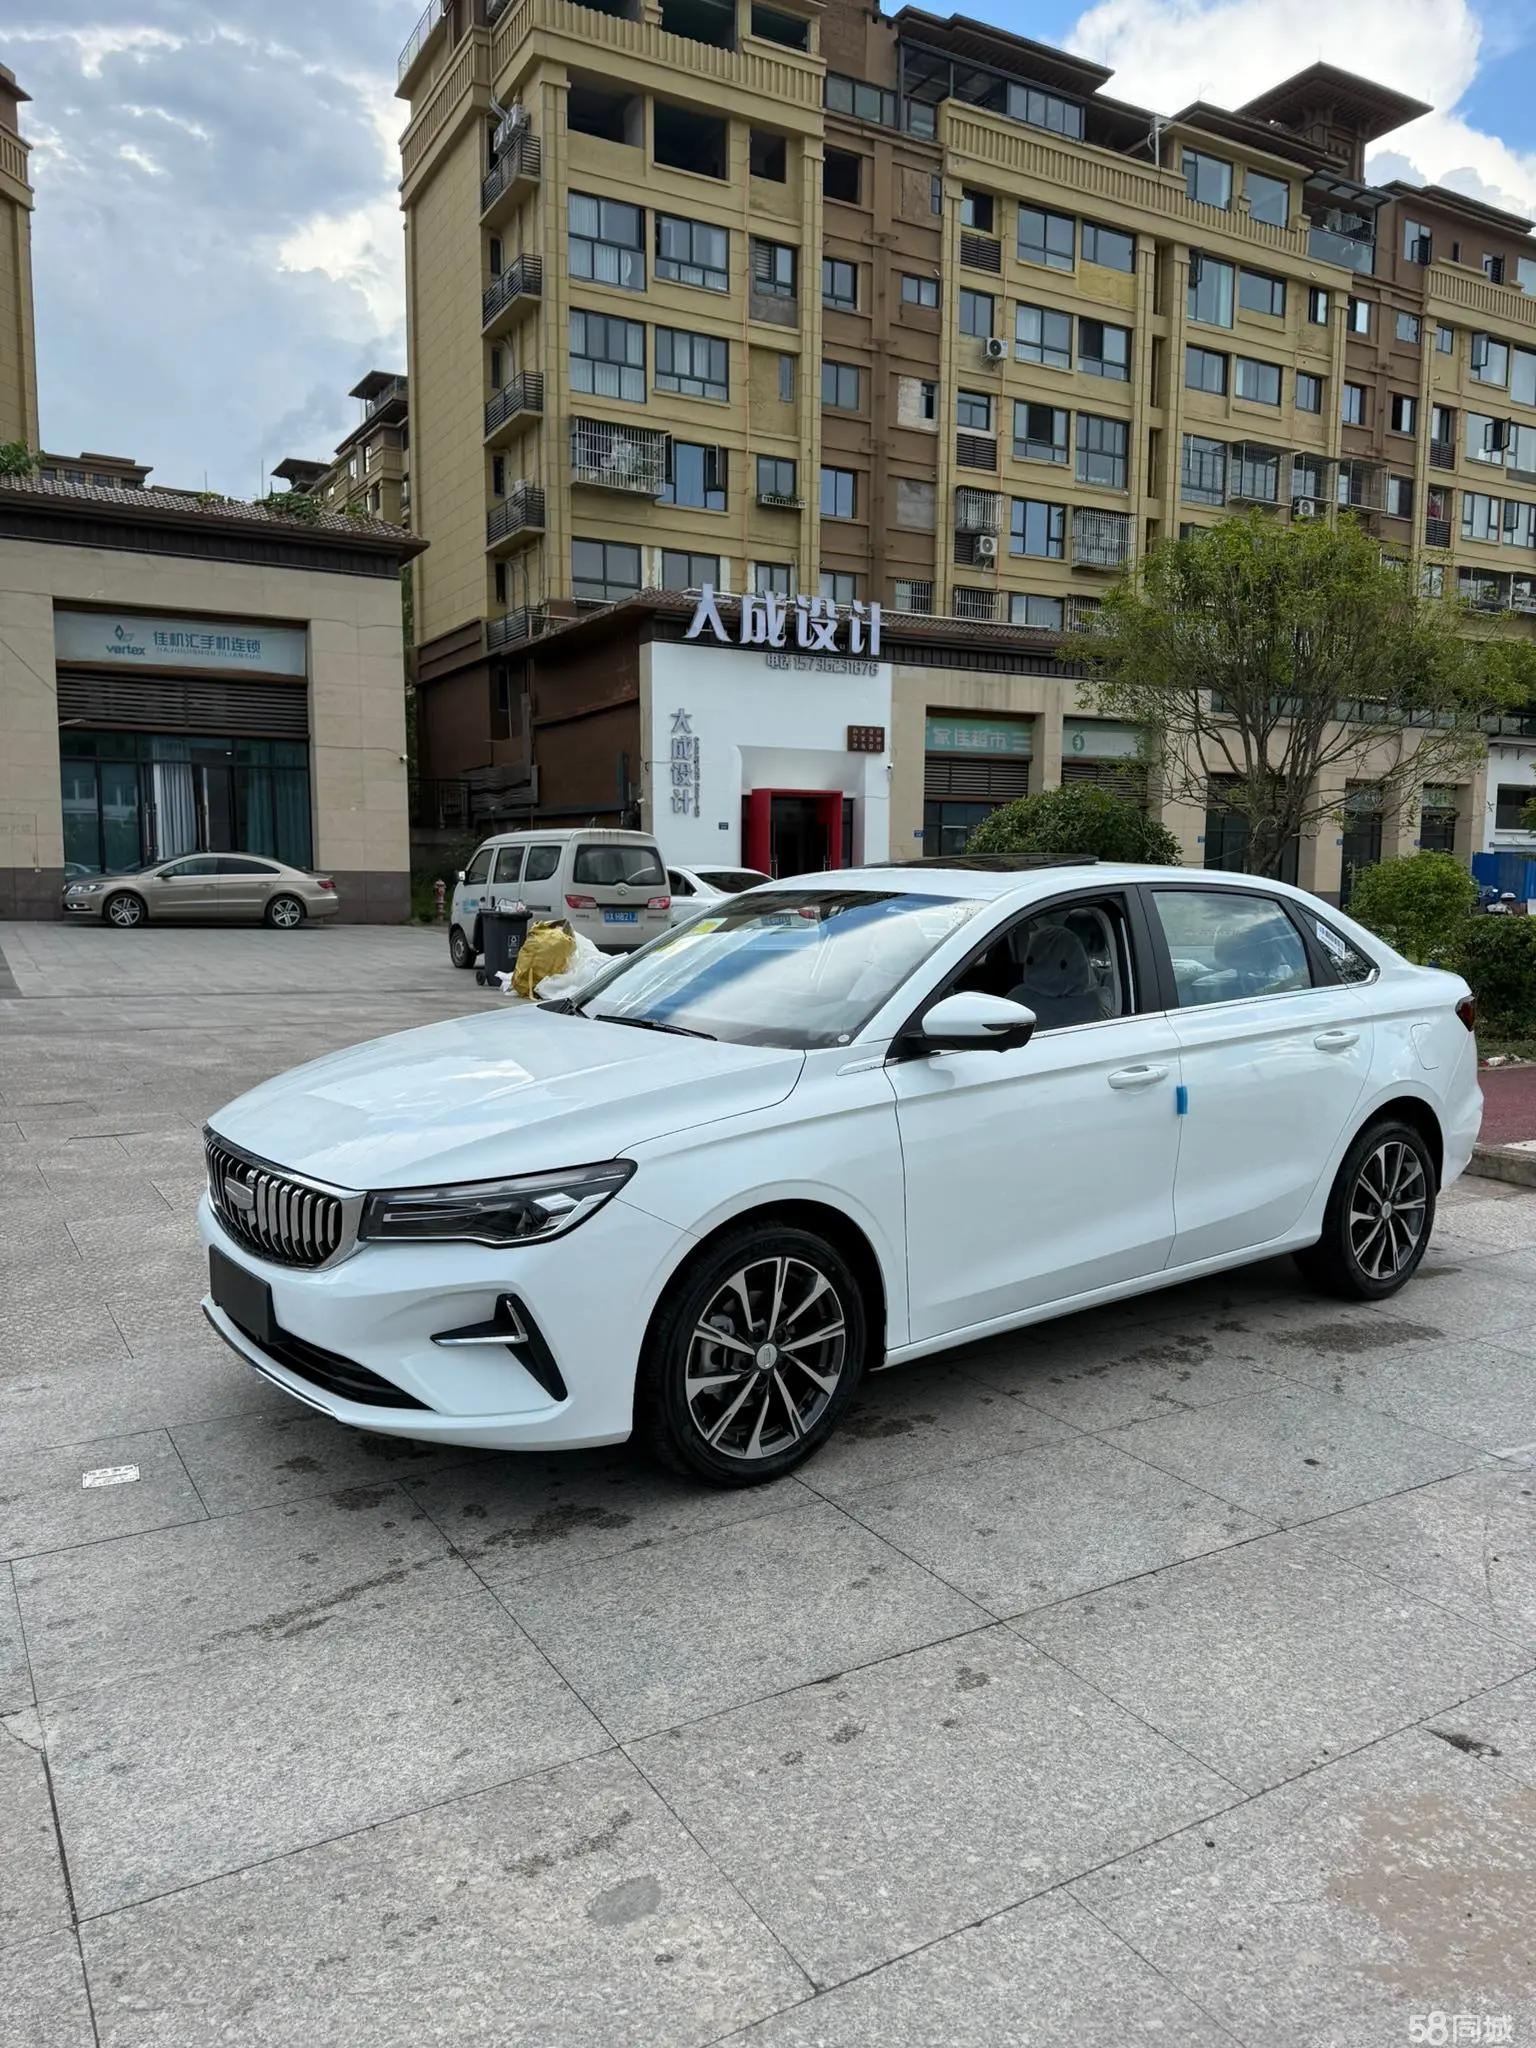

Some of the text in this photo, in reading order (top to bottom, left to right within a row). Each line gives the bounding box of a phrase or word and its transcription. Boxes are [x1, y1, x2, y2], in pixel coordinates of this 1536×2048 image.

[153, 631, 261, 653] 佳机汇手机连锁
[681, 583, 889, 656] 大成设计
[106, 644, 146, 656] vertex
[670, 708, 692, 815] 大成设计
